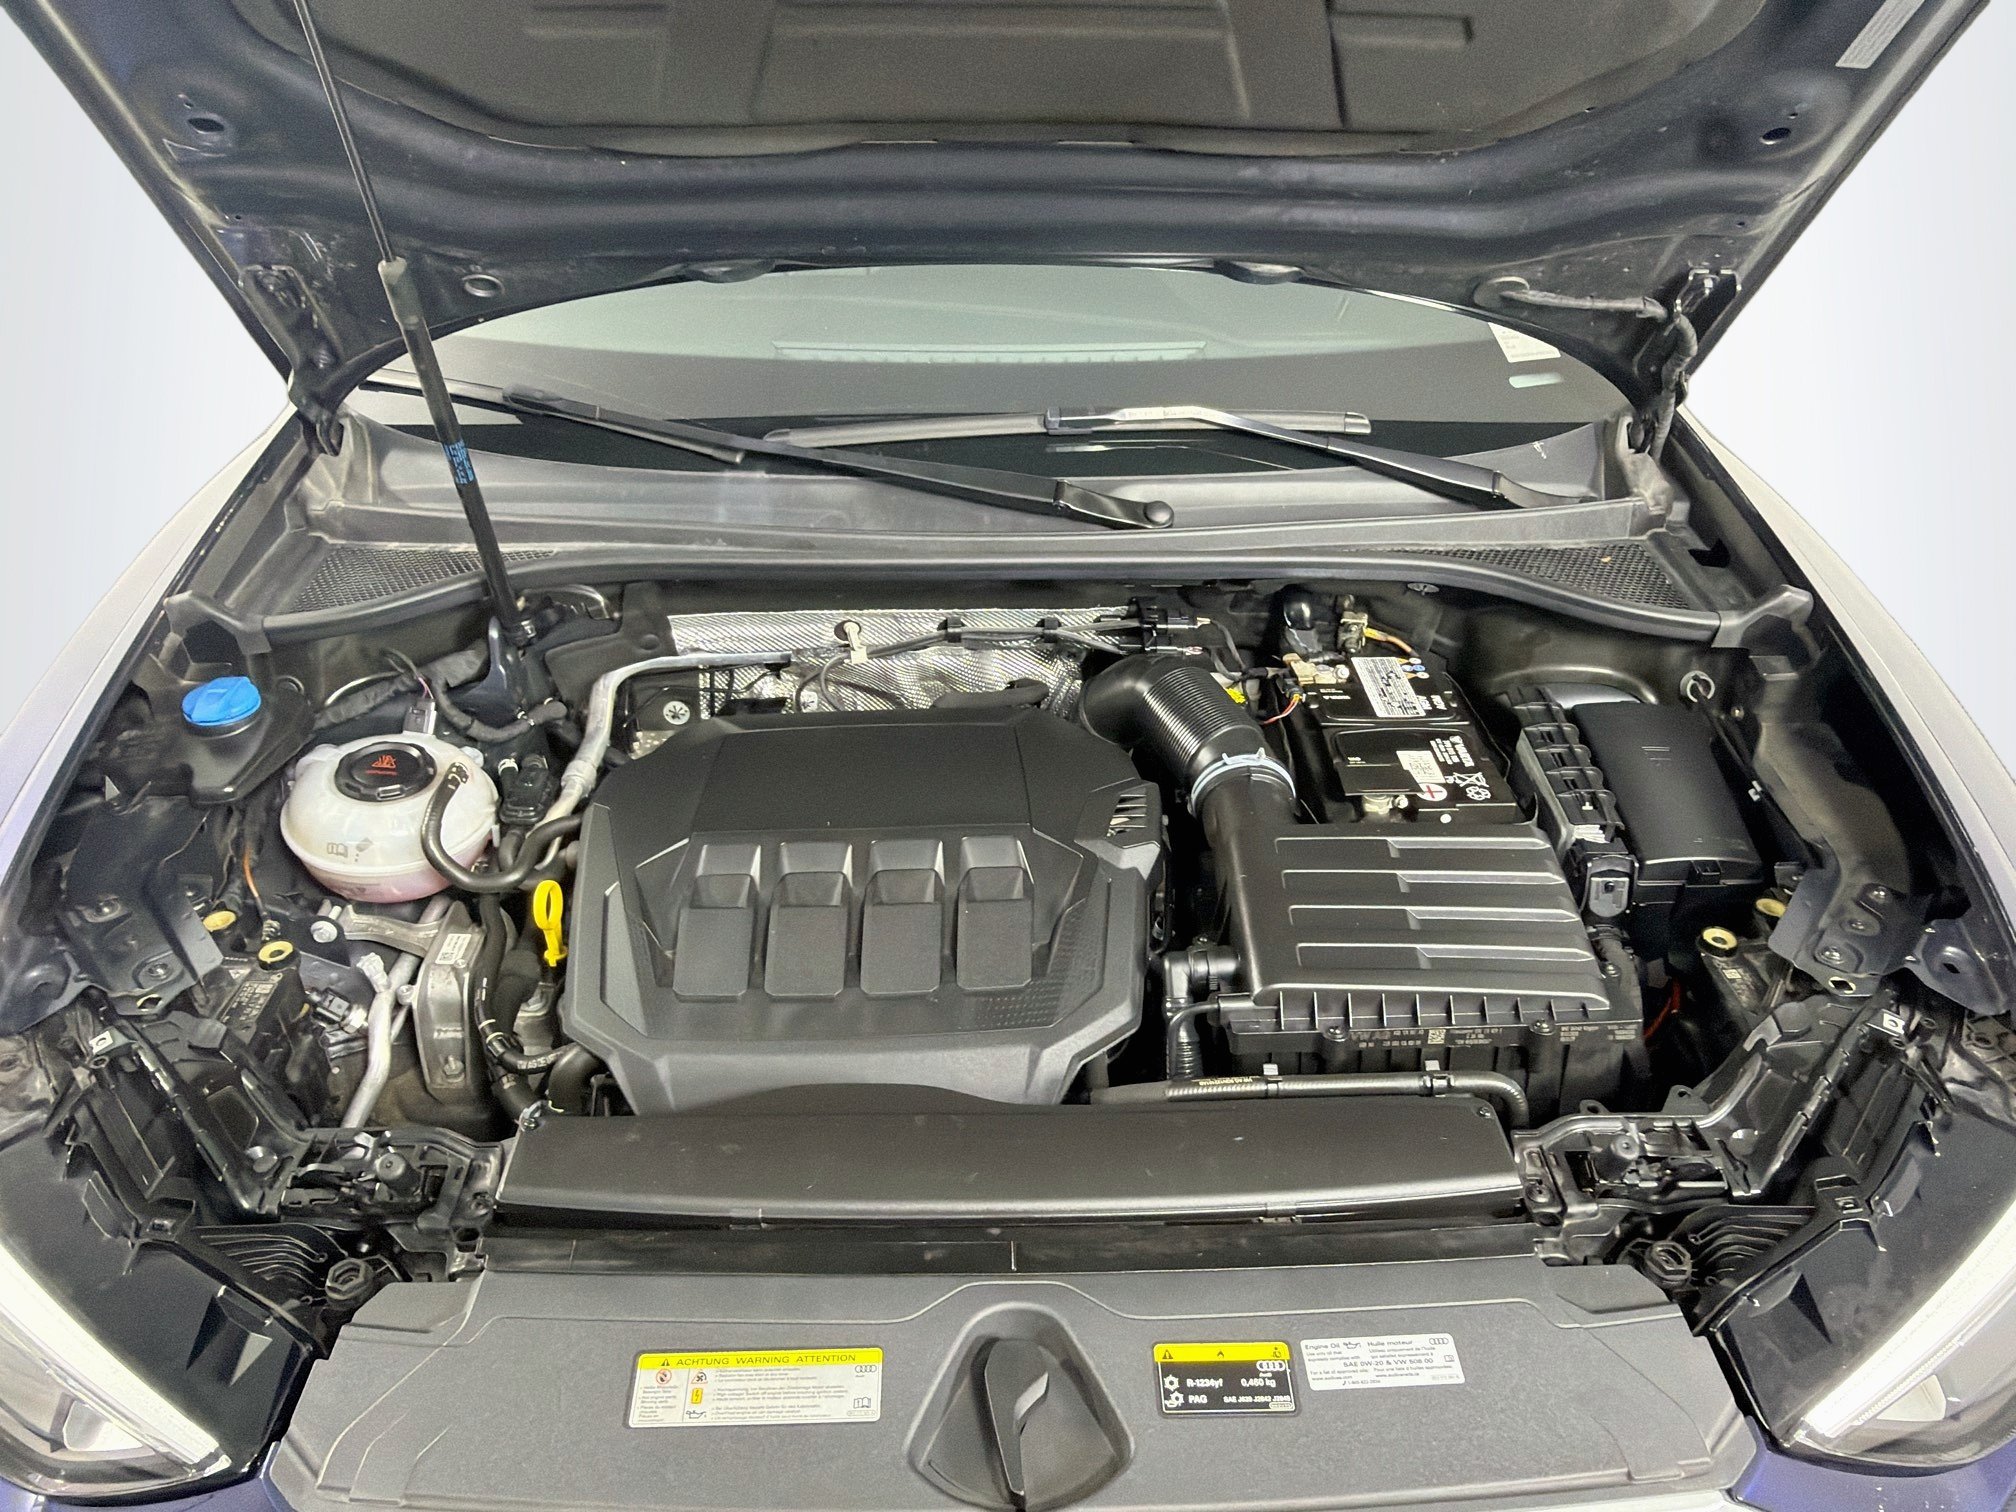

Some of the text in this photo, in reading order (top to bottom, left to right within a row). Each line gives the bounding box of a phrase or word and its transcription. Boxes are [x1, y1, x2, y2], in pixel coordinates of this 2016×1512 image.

[676, 1354, 856, 1367] ACHTUNG WARNING ATTENTION
[1186, 1378, 1224, 1389] R-1234yf
[1265, 1378, 1277, 1388] kg
[1188, 1394, 1208, 1404] PAG
[1223, 1395, 1237, 1403] SAE
